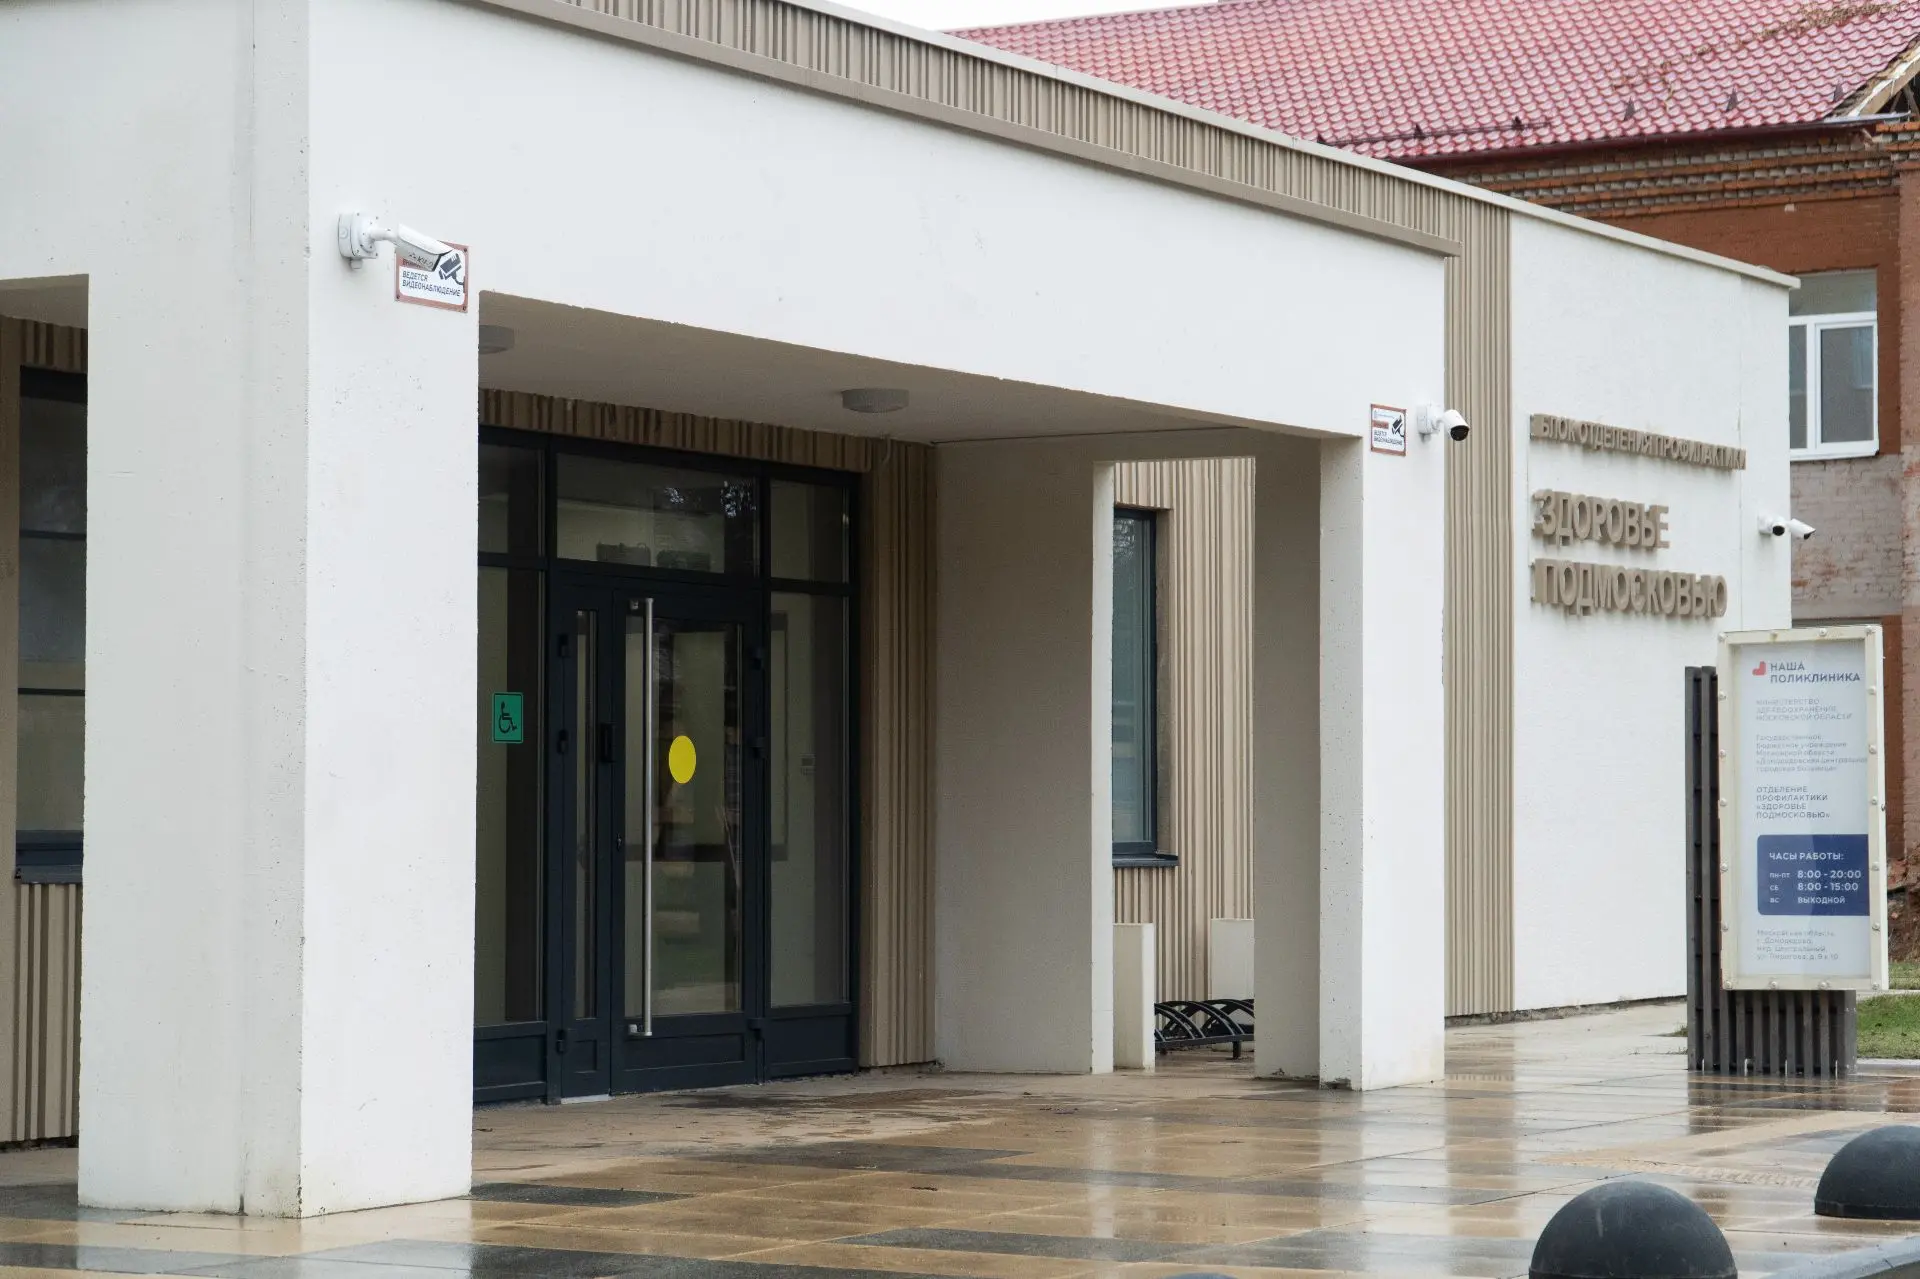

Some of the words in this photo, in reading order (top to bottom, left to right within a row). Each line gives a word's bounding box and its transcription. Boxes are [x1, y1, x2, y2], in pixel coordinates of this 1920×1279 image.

[402, 271, 428, 281] ВЕДЕТСЯ
[402, 280, 461, 296] ВИДЕОНАБЛЮДЕНИЕ
[1533, 414, 1576, 445] БЛОК
[1578, 421, 1651, 453] ОТДЕЛЕНИЯ
[1652, 433, 1746, 470] ПРОФИЛАКТИКИ
[1532, 489, 1670, 549] ЗДОРОВЬЕ
[1532, 558, 1728, 617] ПОДМОСКОВЬЮ
[1770, 662, 1805, 671] НАША
[1770, 673, 1861, 684] ПОЛИКЛИНИКА
[1756, 786, 1808, 794] ОТДЕЛЕНИЕ
[1756, 794, 1828, 802] ПРОФИЛАКТИКИ
[1769, 852, 1797, 860] ЧАСЫ
[1799, 852, 1844, 860] РАБОТЫ:
[1797, 870, 1822, 879] 8:00
[1830, 870, 1862, 879] 20:00
[1797, 882, 1822, 891] 8:00
[1830, 882, 1859, 891] 15:00
[1797, 895, 1846, 904] ВЫХОДНОЙ
